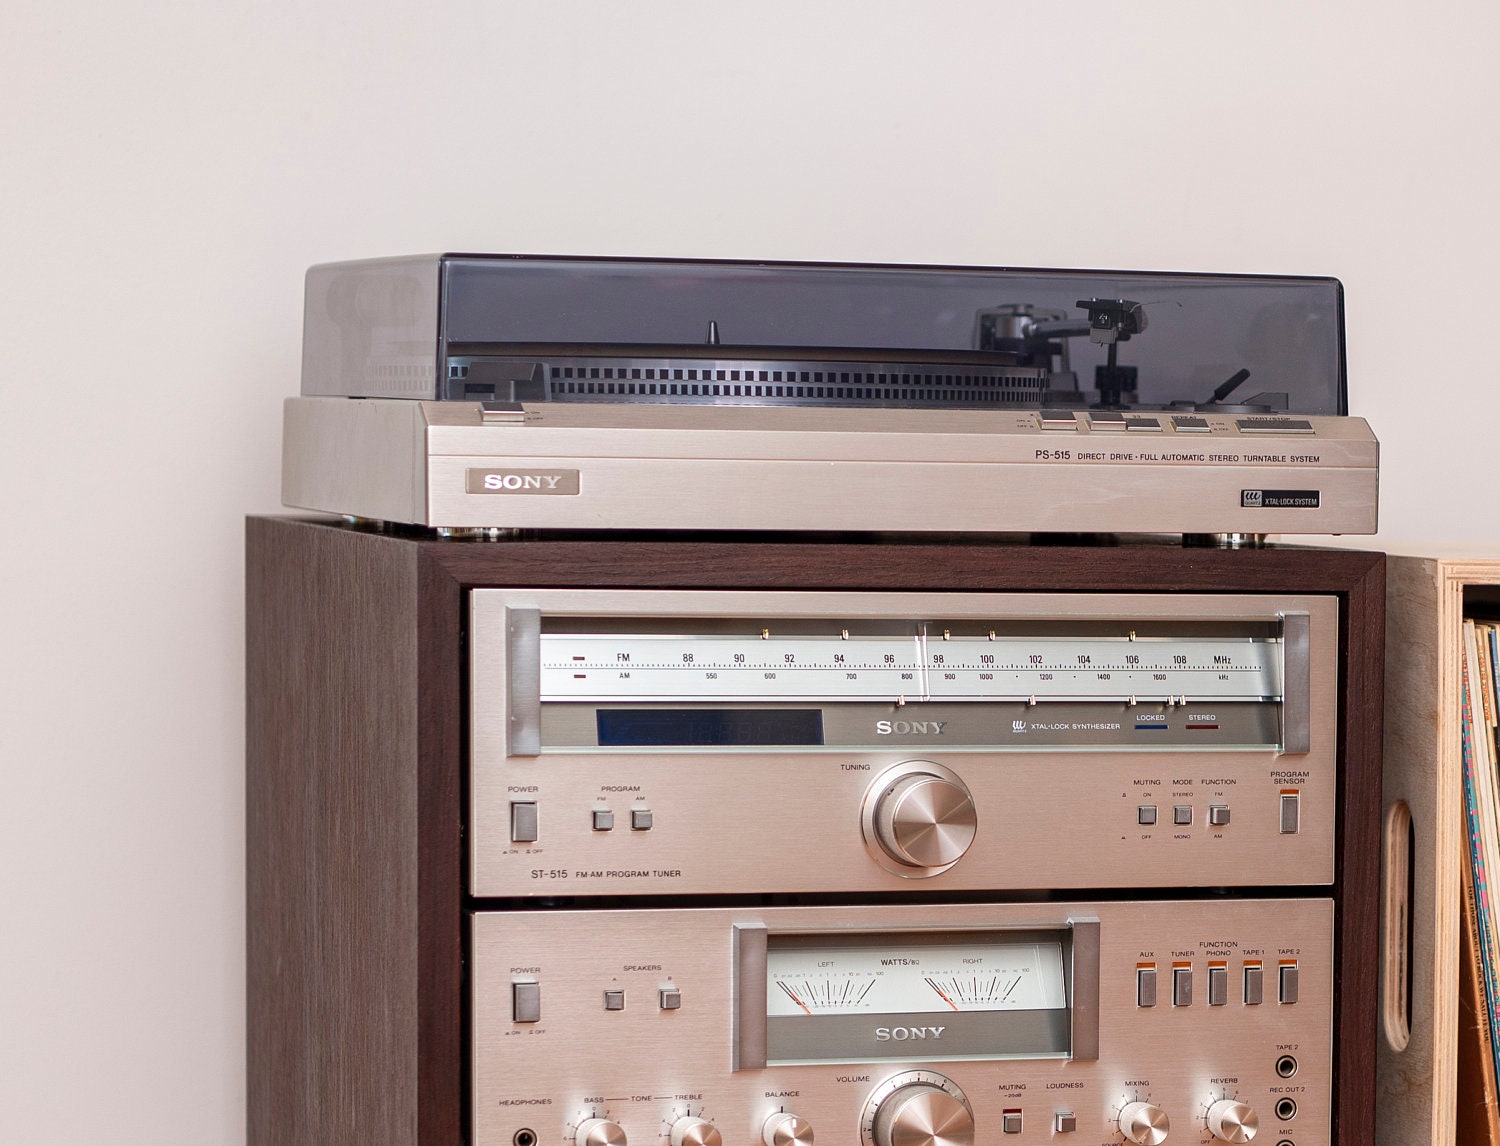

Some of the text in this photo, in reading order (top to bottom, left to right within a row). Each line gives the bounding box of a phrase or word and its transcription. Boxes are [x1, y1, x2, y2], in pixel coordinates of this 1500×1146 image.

[1036, 450, 1070, 460] PS-515
[1140, 453, 1158, 461] FULL
[1161, 453, 1204, 461] AUTOMATIC
[485, 475, 561, 489] SONY
[617, 653, 1231, 664] FM 88 90 92 94 96 98 100 102 104 106 108 MHz
[876, 720, 946, 736] SONY
[532, 870, 567, 879] ST-515
[876, 1027, 945, 1041] SONY
[499, 1098, 552, 1106] HEADPHONES
